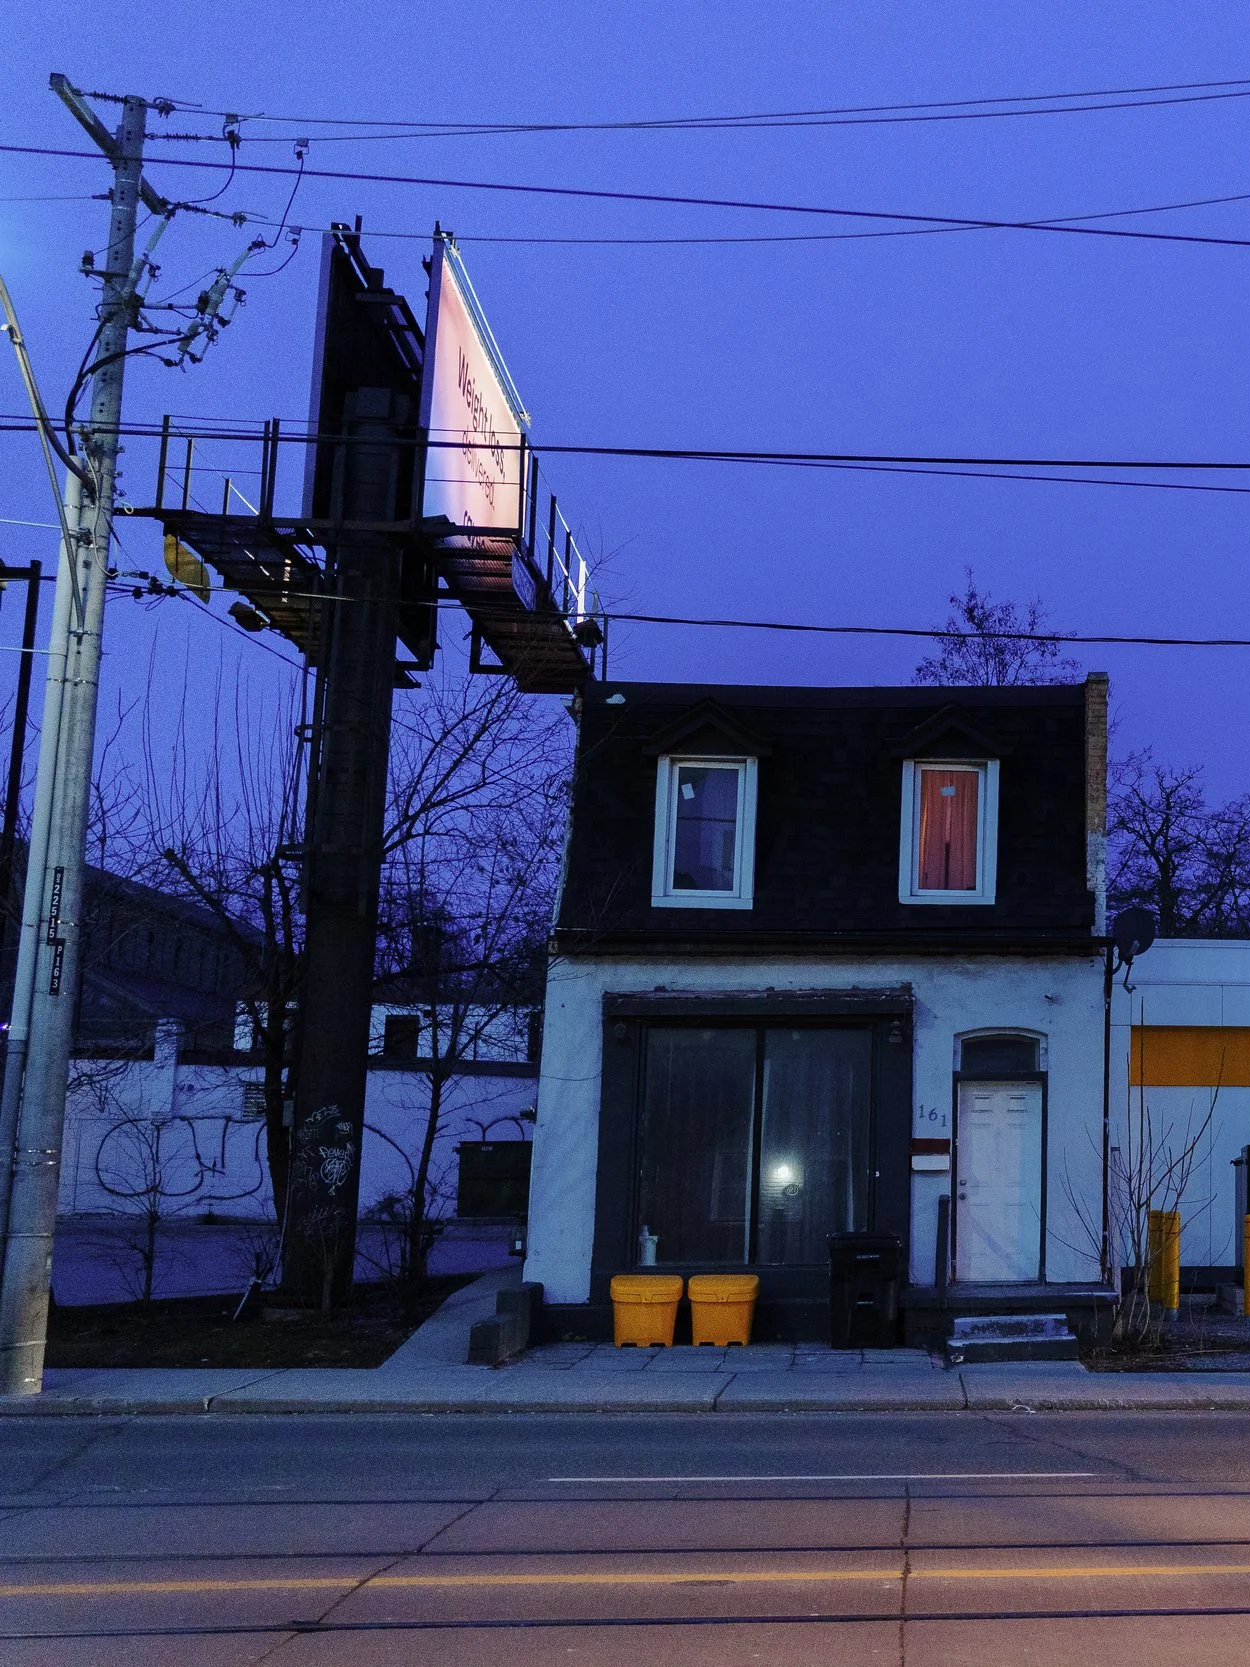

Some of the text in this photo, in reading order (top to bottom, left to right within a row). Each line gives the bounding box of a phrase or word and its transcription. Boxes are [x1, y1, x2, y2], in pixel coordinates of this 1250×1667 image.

[458, 345, 505, 484] Weight loss,
[52, 945, 62, 988] P163
[918, 1104, 948, 1127] 161
